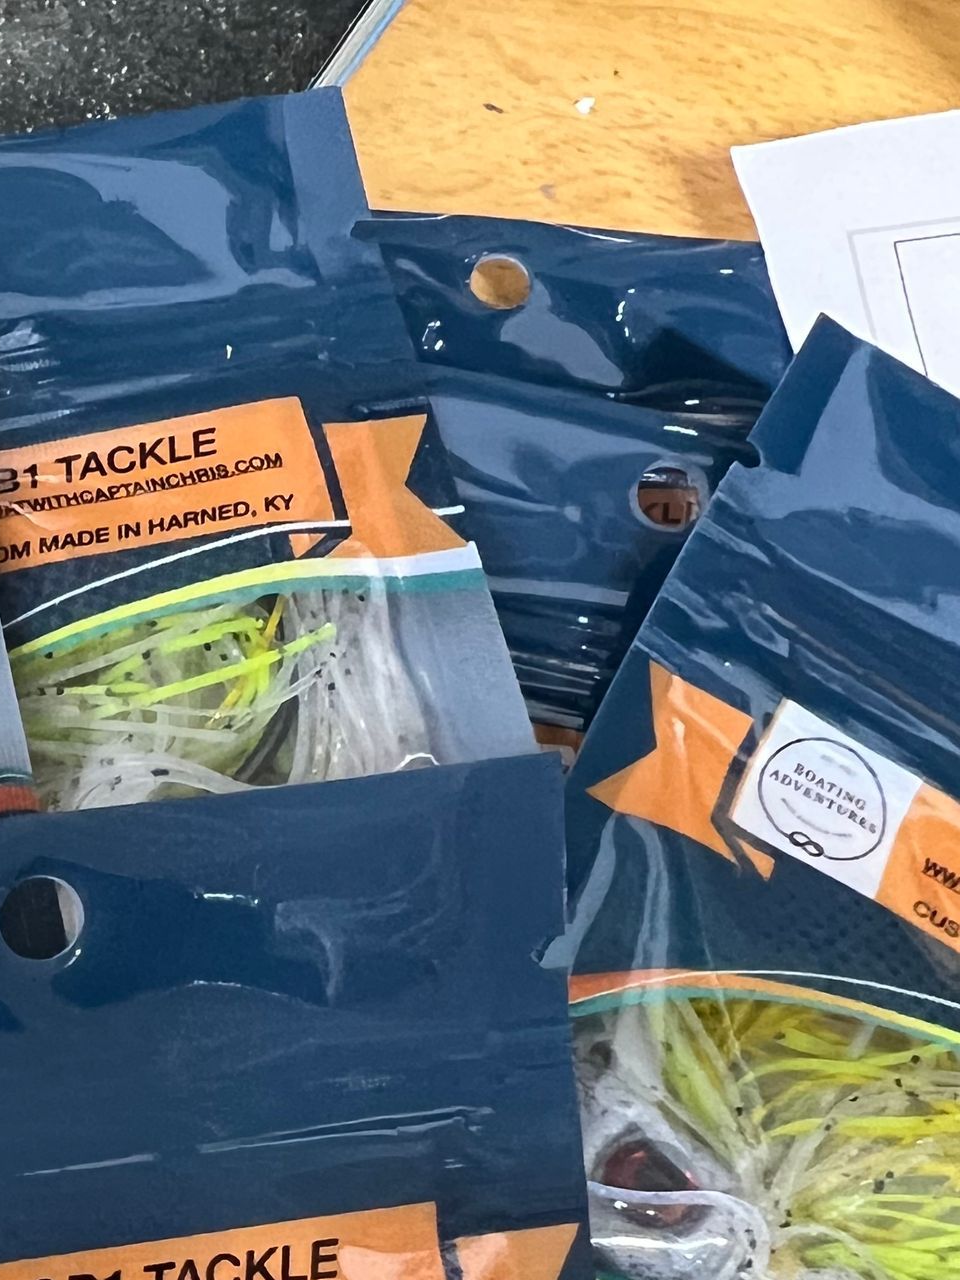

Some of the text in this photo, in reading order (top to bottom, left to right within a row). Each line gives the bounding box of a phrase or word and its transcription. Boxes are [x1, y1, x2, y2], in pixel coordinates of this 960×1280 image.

[56, 427, 217, 484] TACKLE
[40, 527, 109, 552] MADE
[118, 522, 141, 541] IN
[149, 501, 258, 535] HARNED,
[265, 493, 294, 513] KY
[769, 769, 877, 835] ADVENTURES
[794, 762, 867, 811] BOATING
